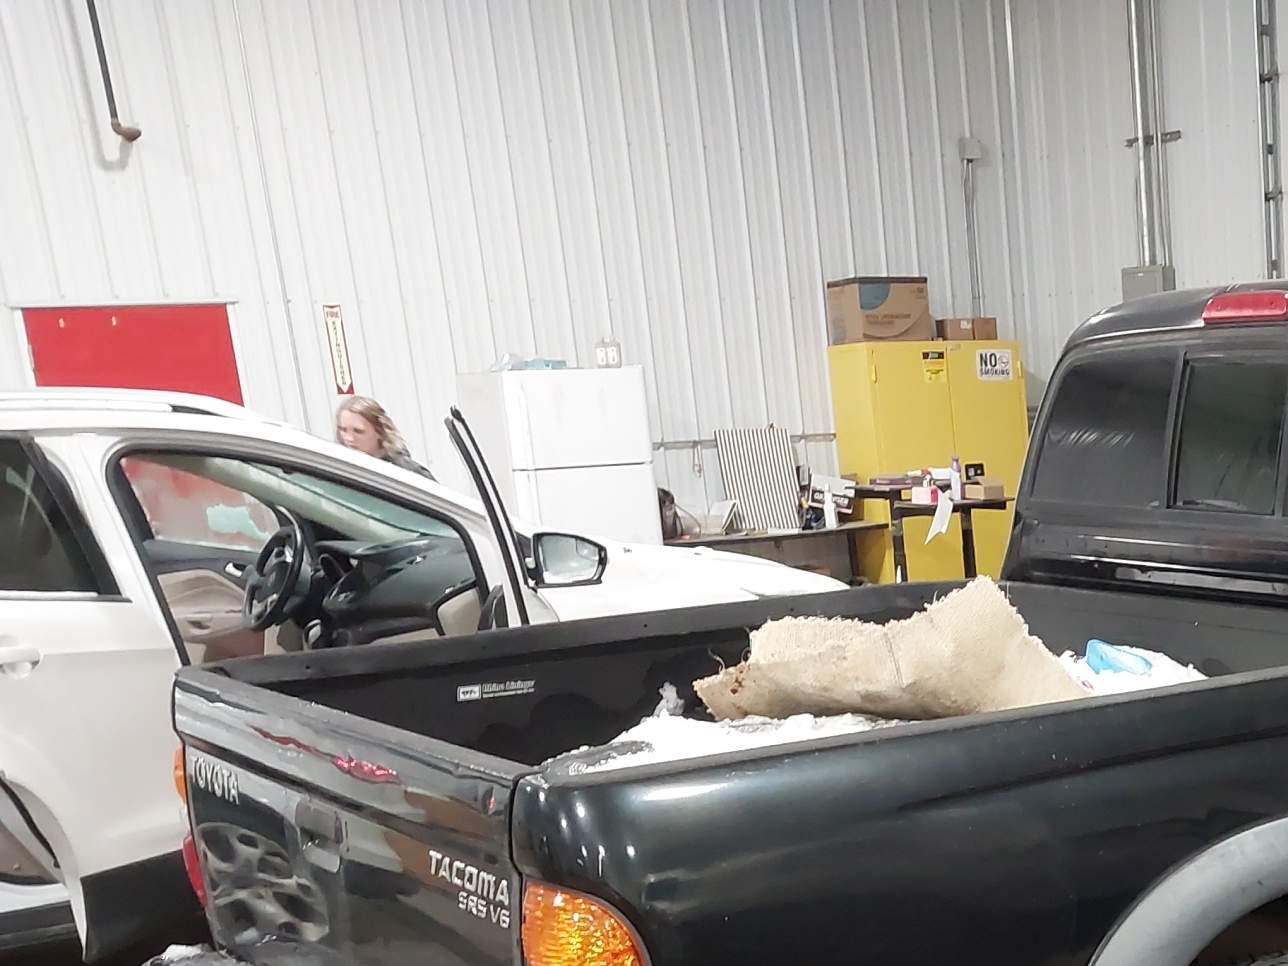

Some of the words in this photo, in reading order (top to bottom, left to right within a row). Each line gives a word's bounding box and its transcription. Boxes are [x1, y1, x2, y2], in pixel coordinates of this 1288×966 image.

[979, 352, 998, 368] NO
[979, 368, 1010, 377] SMOKING
[192, 757, 240, 806] TOYOTA
[428, 849, 510, 907] TACOMA
[489, 903, 511, 929] V6
